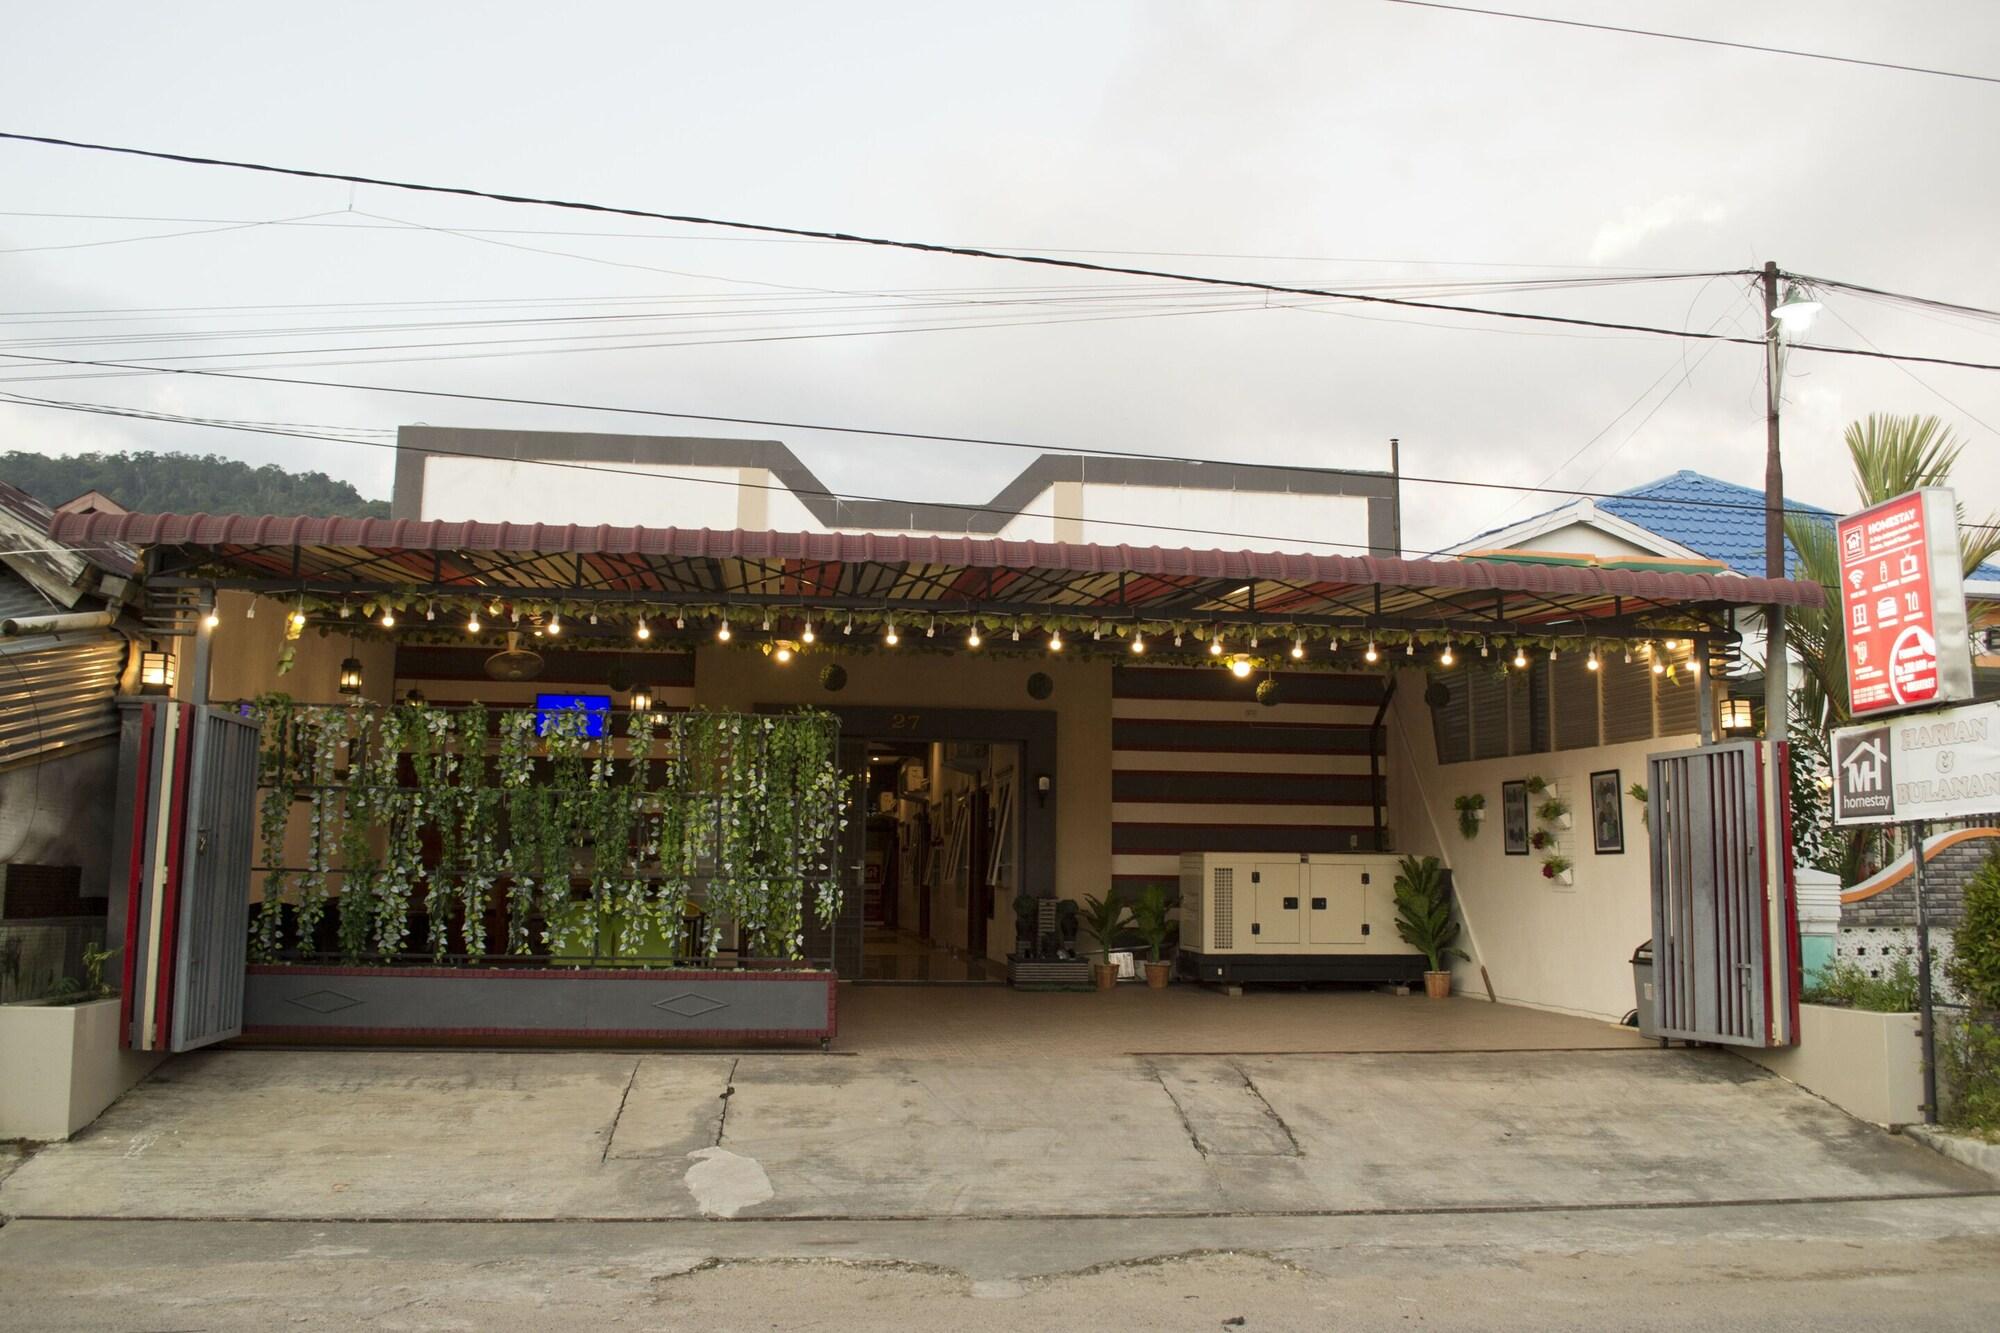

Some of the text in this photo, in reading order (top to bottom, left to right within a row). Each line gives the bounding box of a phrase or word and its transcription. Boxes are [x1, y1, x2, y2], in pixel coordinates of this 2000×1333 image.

[1868, 508, 1916, 533] HOMESTAY
[891, 713, 920, 729] 27
[1901, 717, 1988, 751] HARIAN
[1936, 750, 1954, 774] &
[1896, 771, 2000, 805] BULANAN
[1844, 794, 1889, 810] homestay
